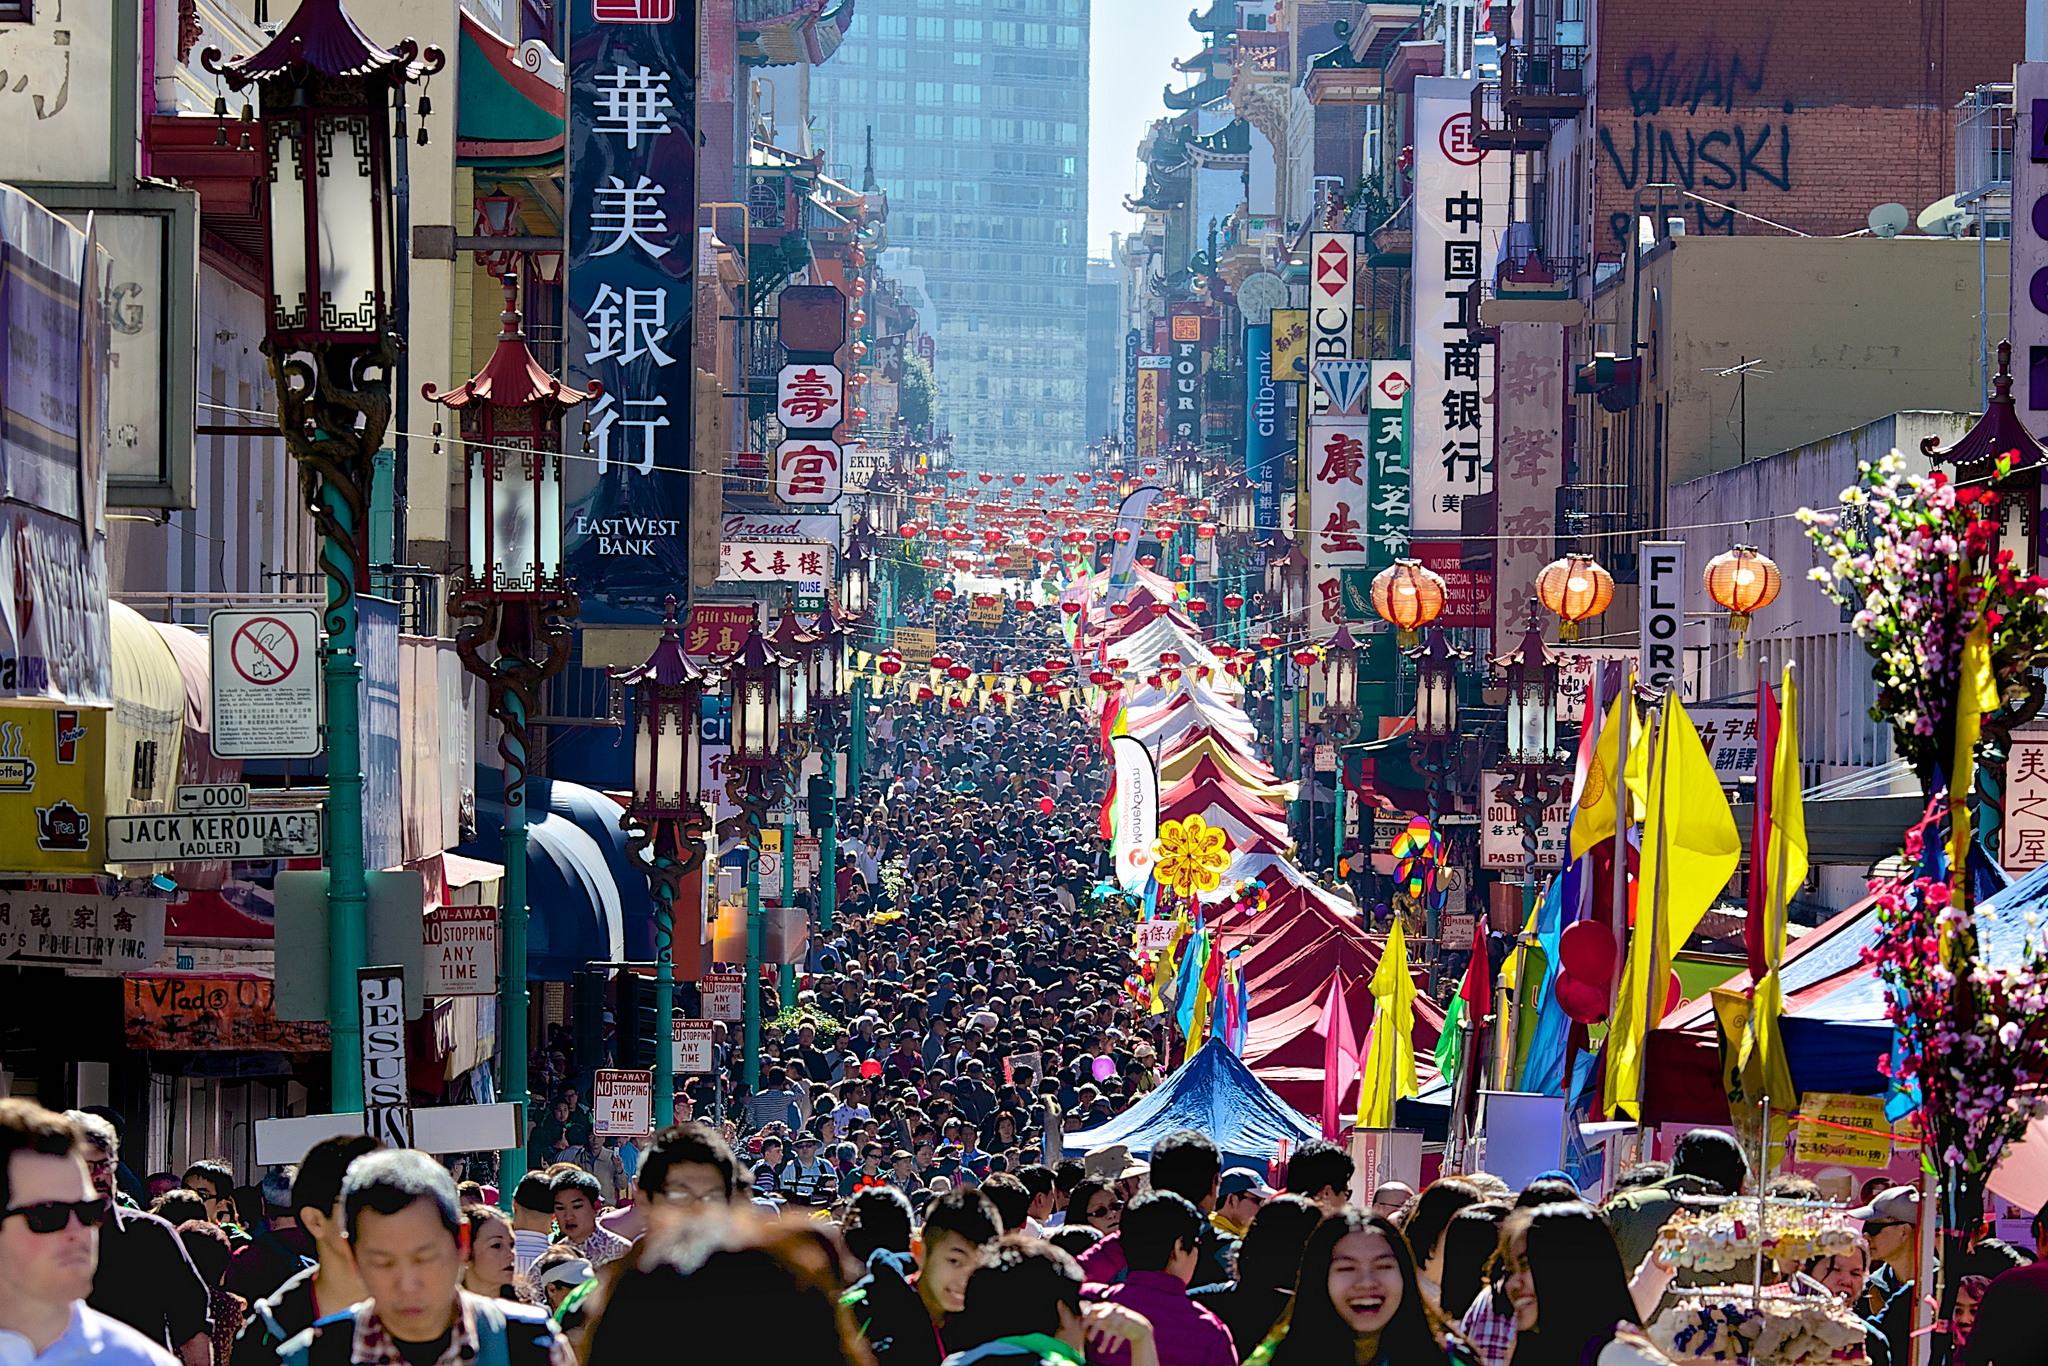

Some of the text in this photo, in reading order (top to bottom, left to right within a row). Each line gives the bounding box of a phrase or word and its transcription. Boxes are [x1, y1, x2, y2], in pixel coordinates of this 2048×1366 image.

[583, 65, 677, 476] 華美銀行
[1442, 191, 1483, 483] 中国工商银行
[1177, 343, 1196, 410] FOUR
[1256, 350, 1276, 437] citibank
[849, 456, 886, 469] EKING
[1371, 416, 1411, 555] 天仁茗茶
[723, 515, 802, 541] Grand
[598, 537, 657, 556] BANK
[740, 550, 823, 576] 天喜樓
[1430, 558, 1461, 570] INDUSTR
[799, 581, 821, 593] OUSE
[696, 610, 719, 624] Gift
[59, 726, 87, 746] Juice
[1715, 747, 1757, 771] 翻譯
[0, 765, 23, 777] offee
[203, 787, 243, 806] 000
[2010, 748, 2048, 864] 美之屋
[1487, 806, 1518, 823] GOLD
[54, 821, 74, 834] Tea
[121, 818, 182, 844] JACK
[179, 841, 241, 857] (ADLER)
[444, 925, 493, 942] STOPPING
[39, 933, 115, 957] POULTRY
[443, 946, 475, 962] ANY
[440, 964, 478, 980] TIME
[703, 983, 741, 994] NO STOPPING
[714, 994, 730, 1003] ANY
[713, 1003, 731, 1013] TIME
[365, 978, 404, 1106] JESUS
[682, 1031, 711, 1041] STOPPING
[681, 1043, 699, 1052] ANY
[680, 1053, 700, 1063] TIME
[600, 1072, 647, 1081] TOW-AWAY
[597, 1081, 648, 1096] NO STOPPING
[611, 1098, 633, 1109] ANY
[610, 1110, 634, 1122] TIME
